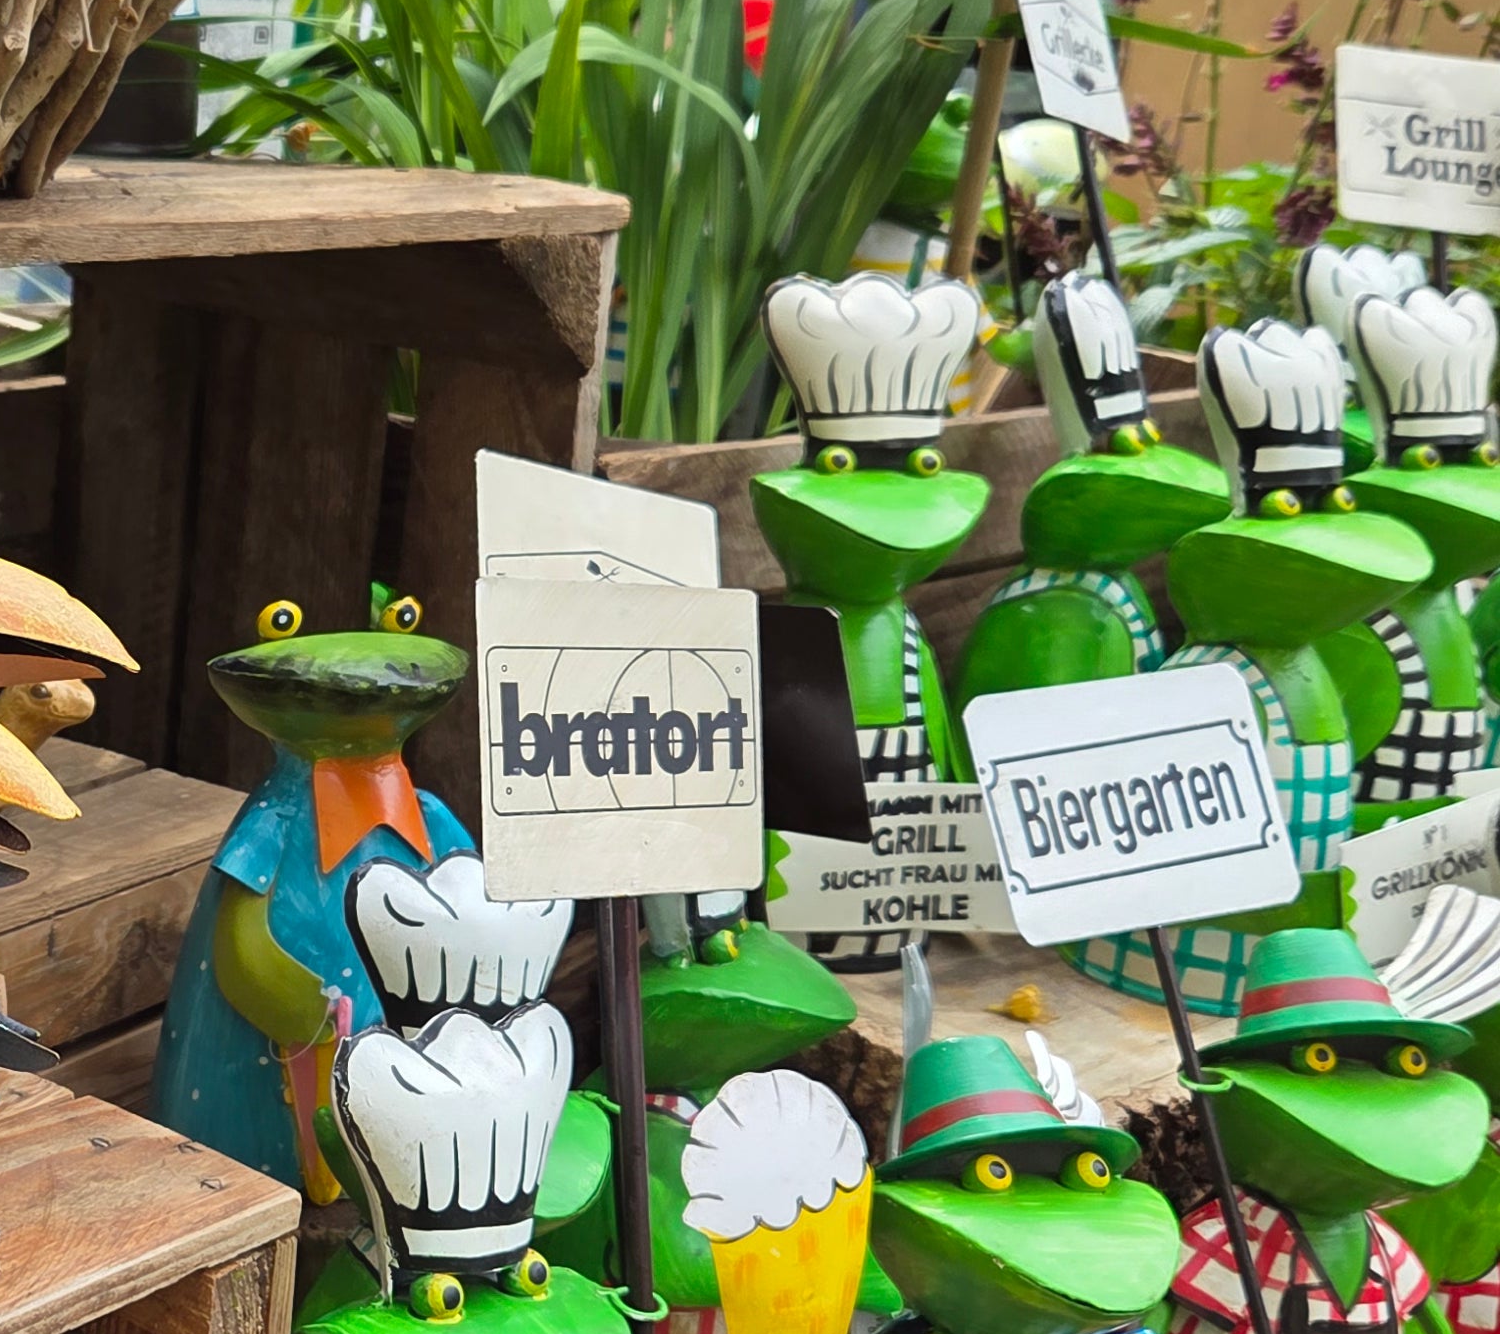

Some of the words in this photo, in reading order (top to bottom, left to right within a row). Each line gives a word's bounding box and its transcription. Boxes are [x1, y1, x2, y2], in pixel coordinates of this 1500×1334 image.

[1403, 113, 1486, 153] Grill
[500, 682, 748, 778] bratort
[940, 794, 983, 814] MIT
[1011, 761, 1246, 858] Biergarten
[872, 824, 967, 857] GRILL
[820, 867, 895, 892] SUCHT
[901, 864, 968, 885] FRAU
[975, 864, 1004, 883] MI
[863, 895, 970, 926] KOHLE
